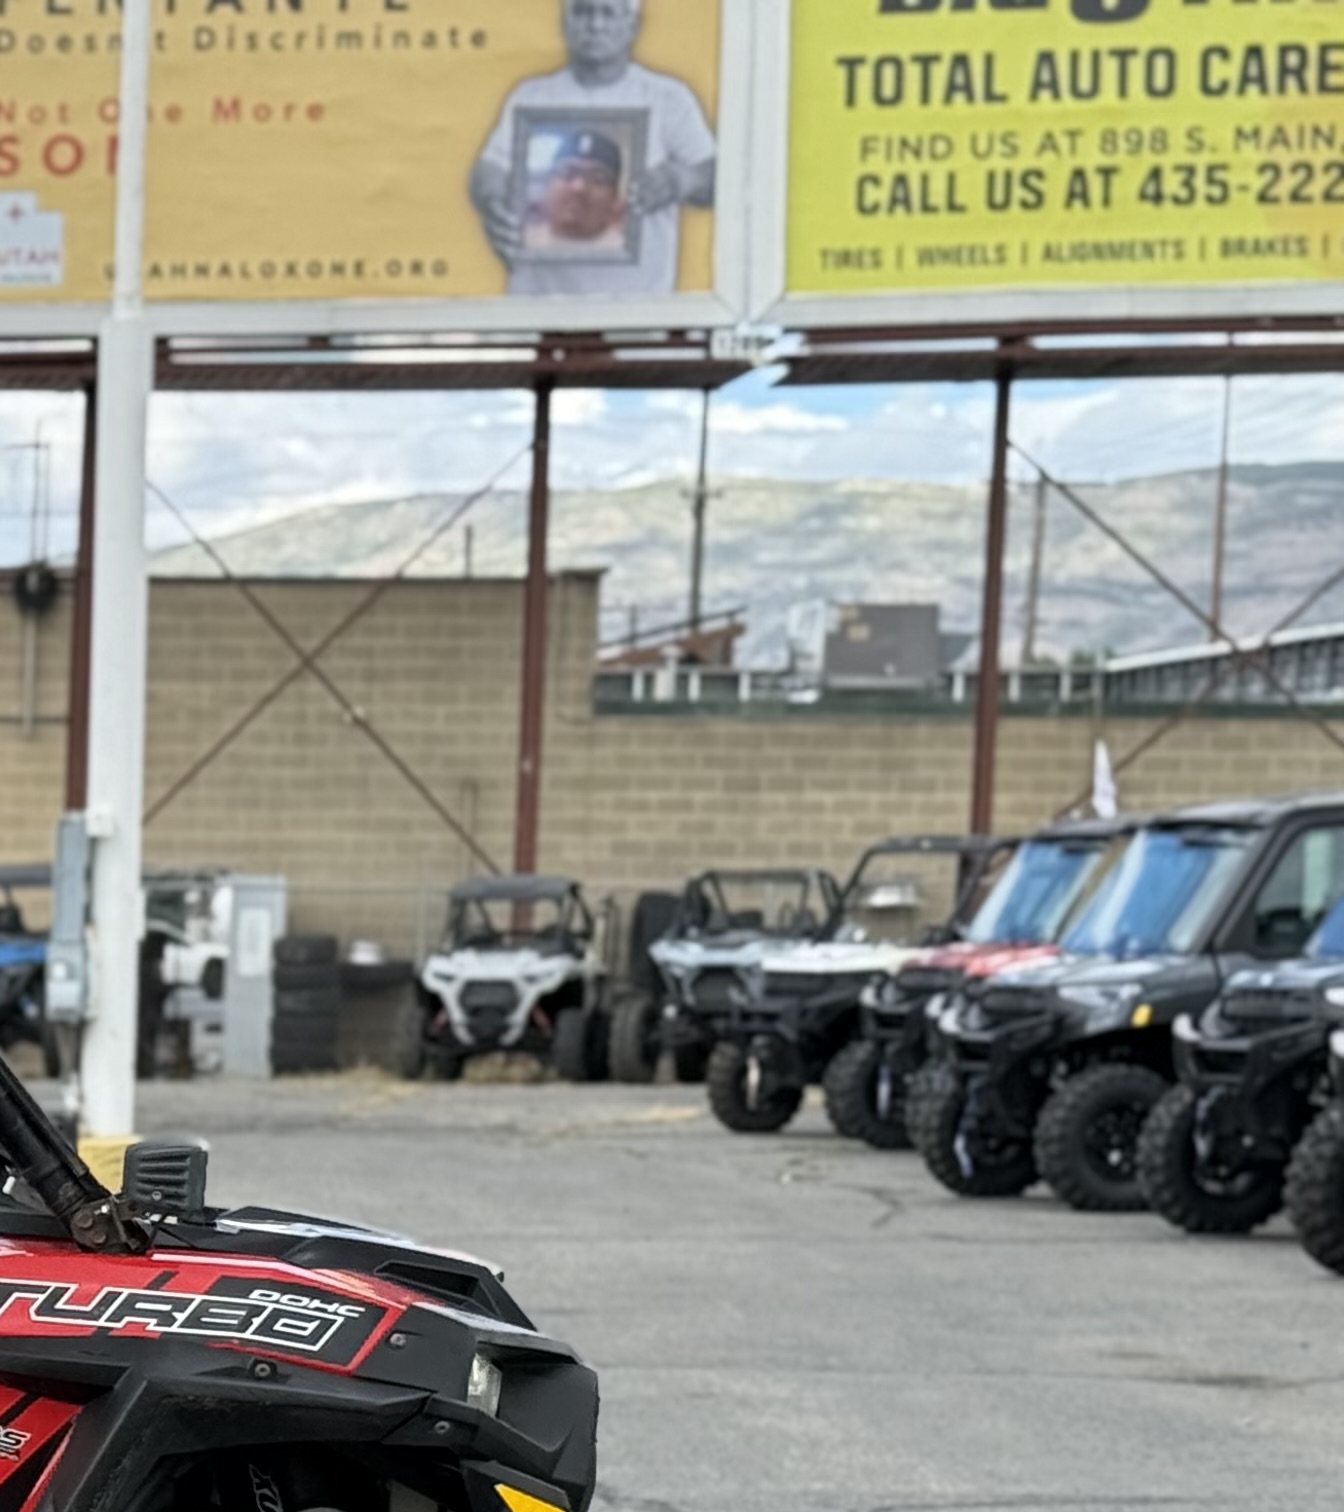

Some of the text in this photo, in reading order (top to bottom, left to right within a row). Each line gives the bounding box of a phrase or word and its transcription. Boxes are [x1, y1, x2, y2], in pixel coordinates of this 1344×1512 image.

[195, 24, 487, 53] Discriminate
[835, 43, 1344, 108] TOTAL AUTO CARE
[98, 98, 184, 123] Oe
[213, 96, 326, 122] More
[861, 133, 954, 163] FIND
[969, 130, 1020, 161] US
[1036, 129, 1086, 158] AT
[1099, 126, 1169, 156] 898
[1185, 124, 1218, 154] S.
[856, 171, 966, 216] CALL
[986, 167, 1046, 212] US
[1063, 164, 1120, 209] AT
[819, 233, 1310, 270] TIRES WHEELS ALIGNMENTS BRAKES
[103, 258, 449, 281] UAHNALOXONE.ORG
[247, 1288, 366, 1319] DOHC
